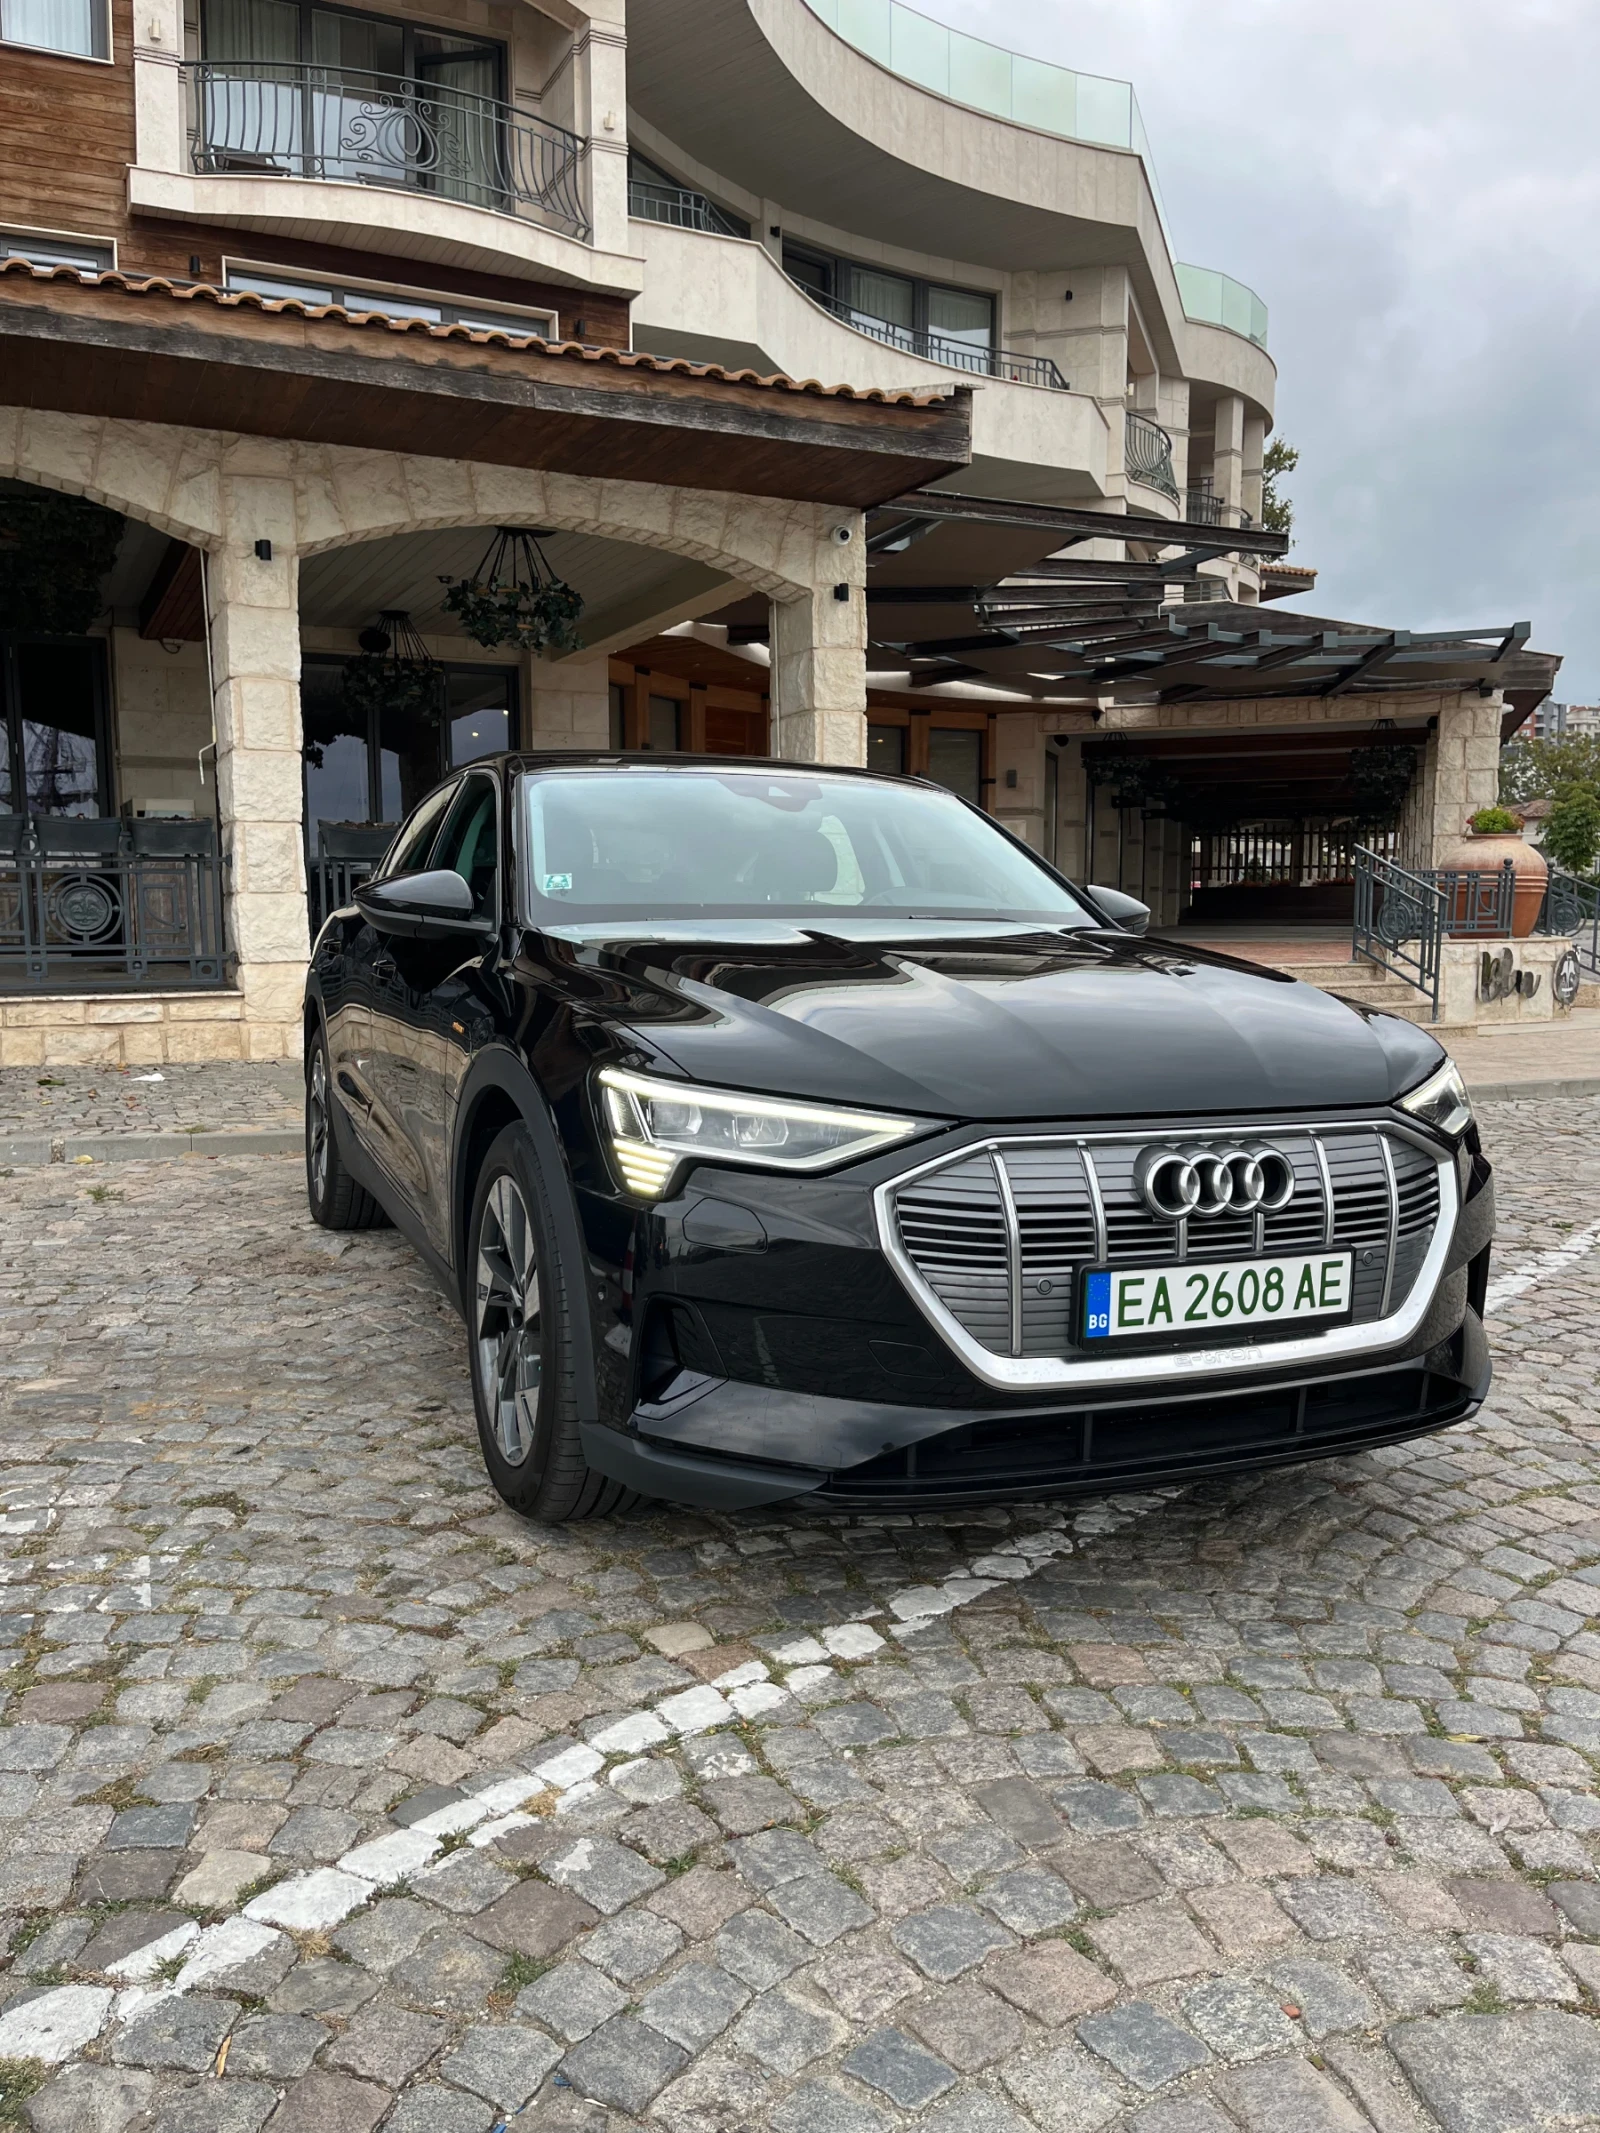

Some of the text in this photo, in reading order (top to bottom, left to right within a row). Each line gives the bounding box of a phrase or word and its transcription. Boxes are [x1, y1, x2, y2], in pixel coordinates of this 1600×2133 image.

[1117, 1260, 1344, 1328] EA 2608 AE
[1088, 1314, 1108, 1330] BG
[1173, 1346, 1263, 1367] e-tron
